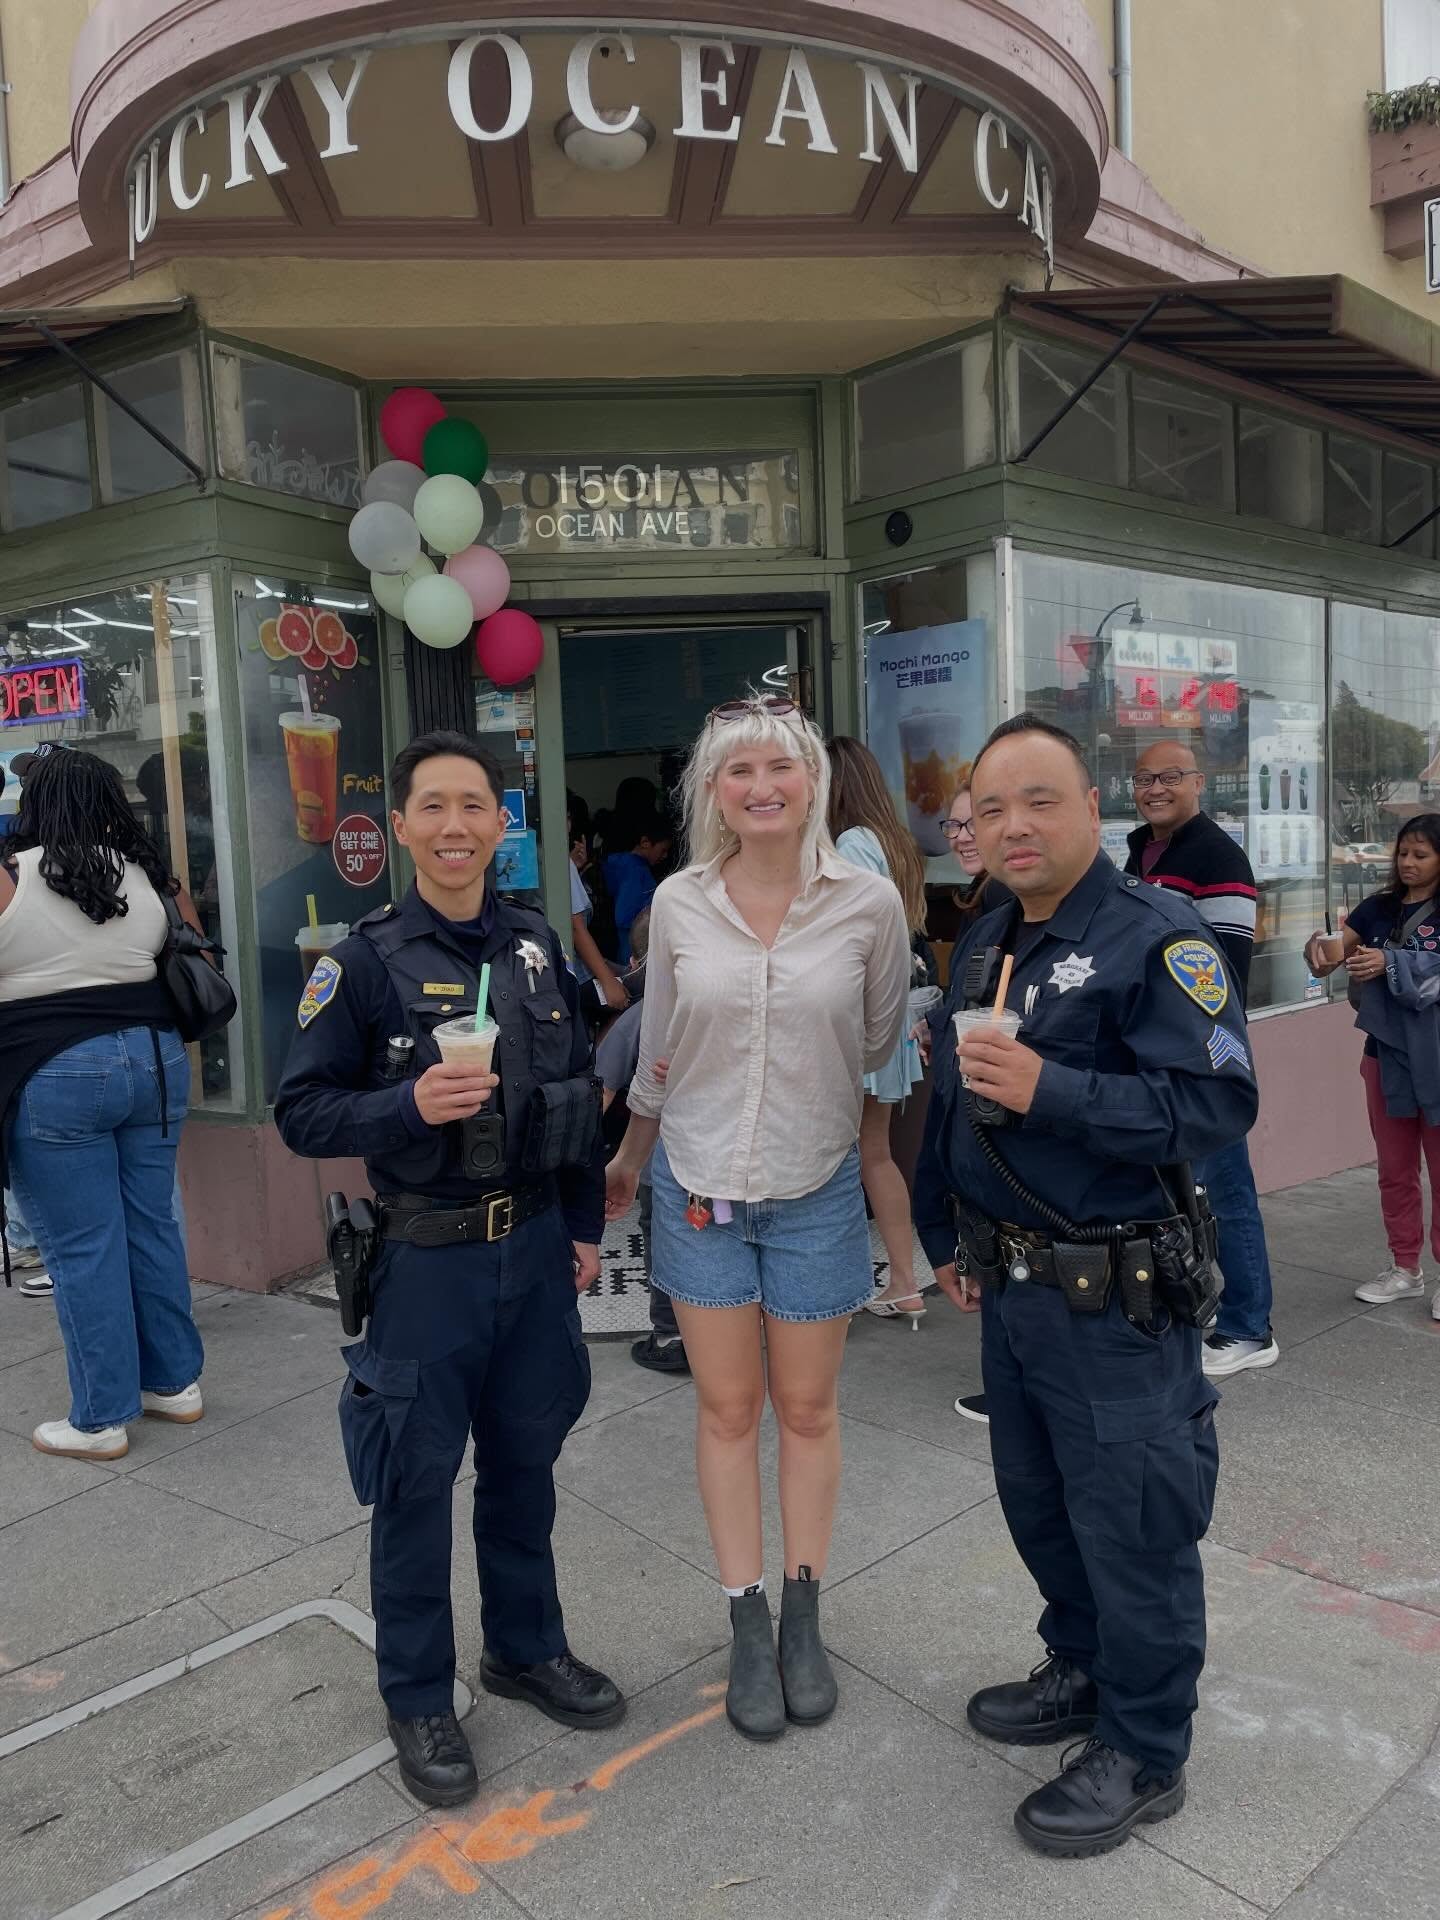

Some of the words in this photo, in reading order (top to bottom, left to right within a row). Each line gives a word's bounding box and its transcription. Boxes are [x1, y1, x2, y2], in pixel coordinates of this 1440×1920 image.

[129, 49, 373, 262] UCKY
[447, 33, 923, 174] OCEAN
[975, 110, 1055, 277] CA
[559, 463, 662, 504] 1501
[535, 512, 624, 539] OCEAN
[640, 510, 698, 536] AVE.
[880, 656, 918, 673] Mochi
[921, 650, 970, 667] Mango
[343, 773, 382, 795] Fruit
[339, 831, 358, 841] BUY
[360, 831, 379, 841] ONE
[341, 840, 358, 850] GET
[360, 840, 379, 850] ONE
